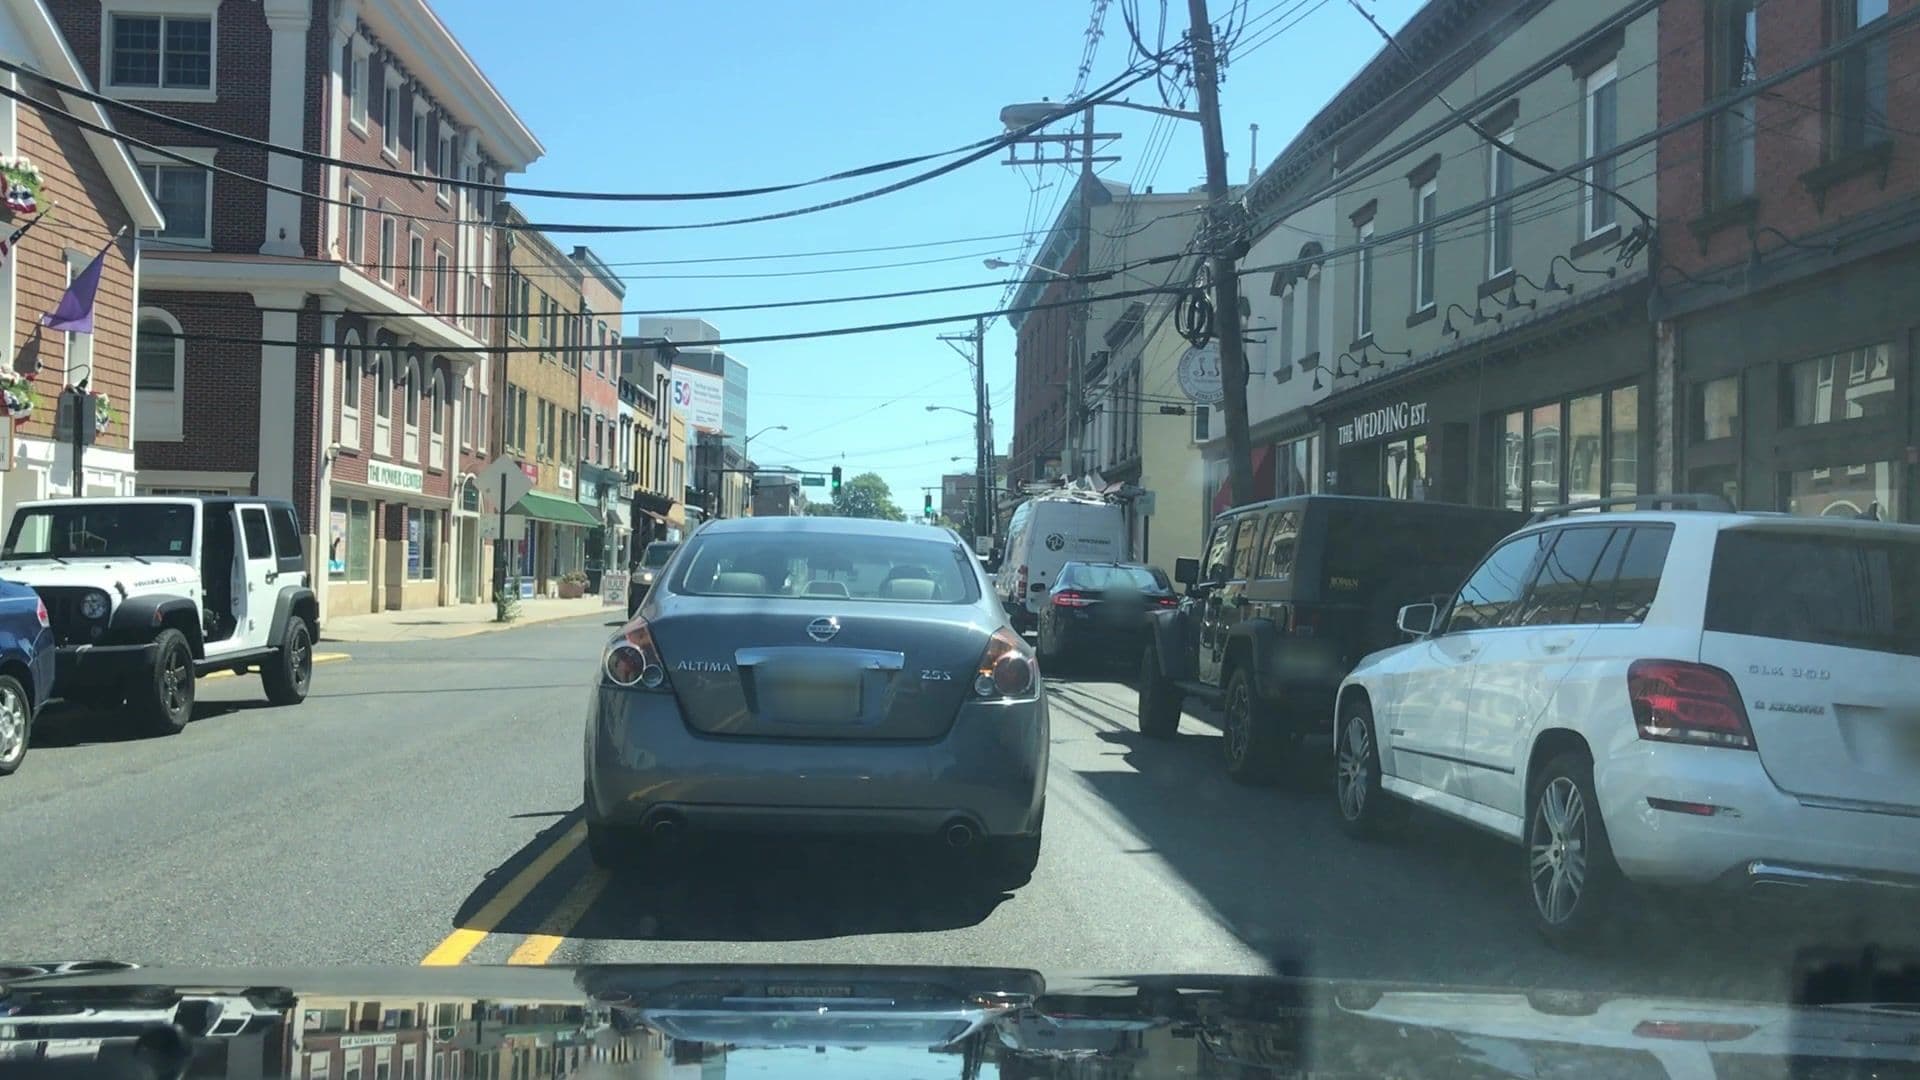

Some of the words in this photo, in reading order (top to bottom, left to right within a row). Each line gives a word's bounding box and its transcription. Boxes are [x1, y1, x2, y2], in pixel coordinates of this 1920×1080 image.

[1338, 424, 1354, 445] THE
[1354, 402, 1408, 441] WEDDING
[369, 465, 380, 482] THE
[381, 468, 402, 486] POWER
[402, 471, 422, 490] CENTER
[677, 660, 732, 672] ALTIMA
